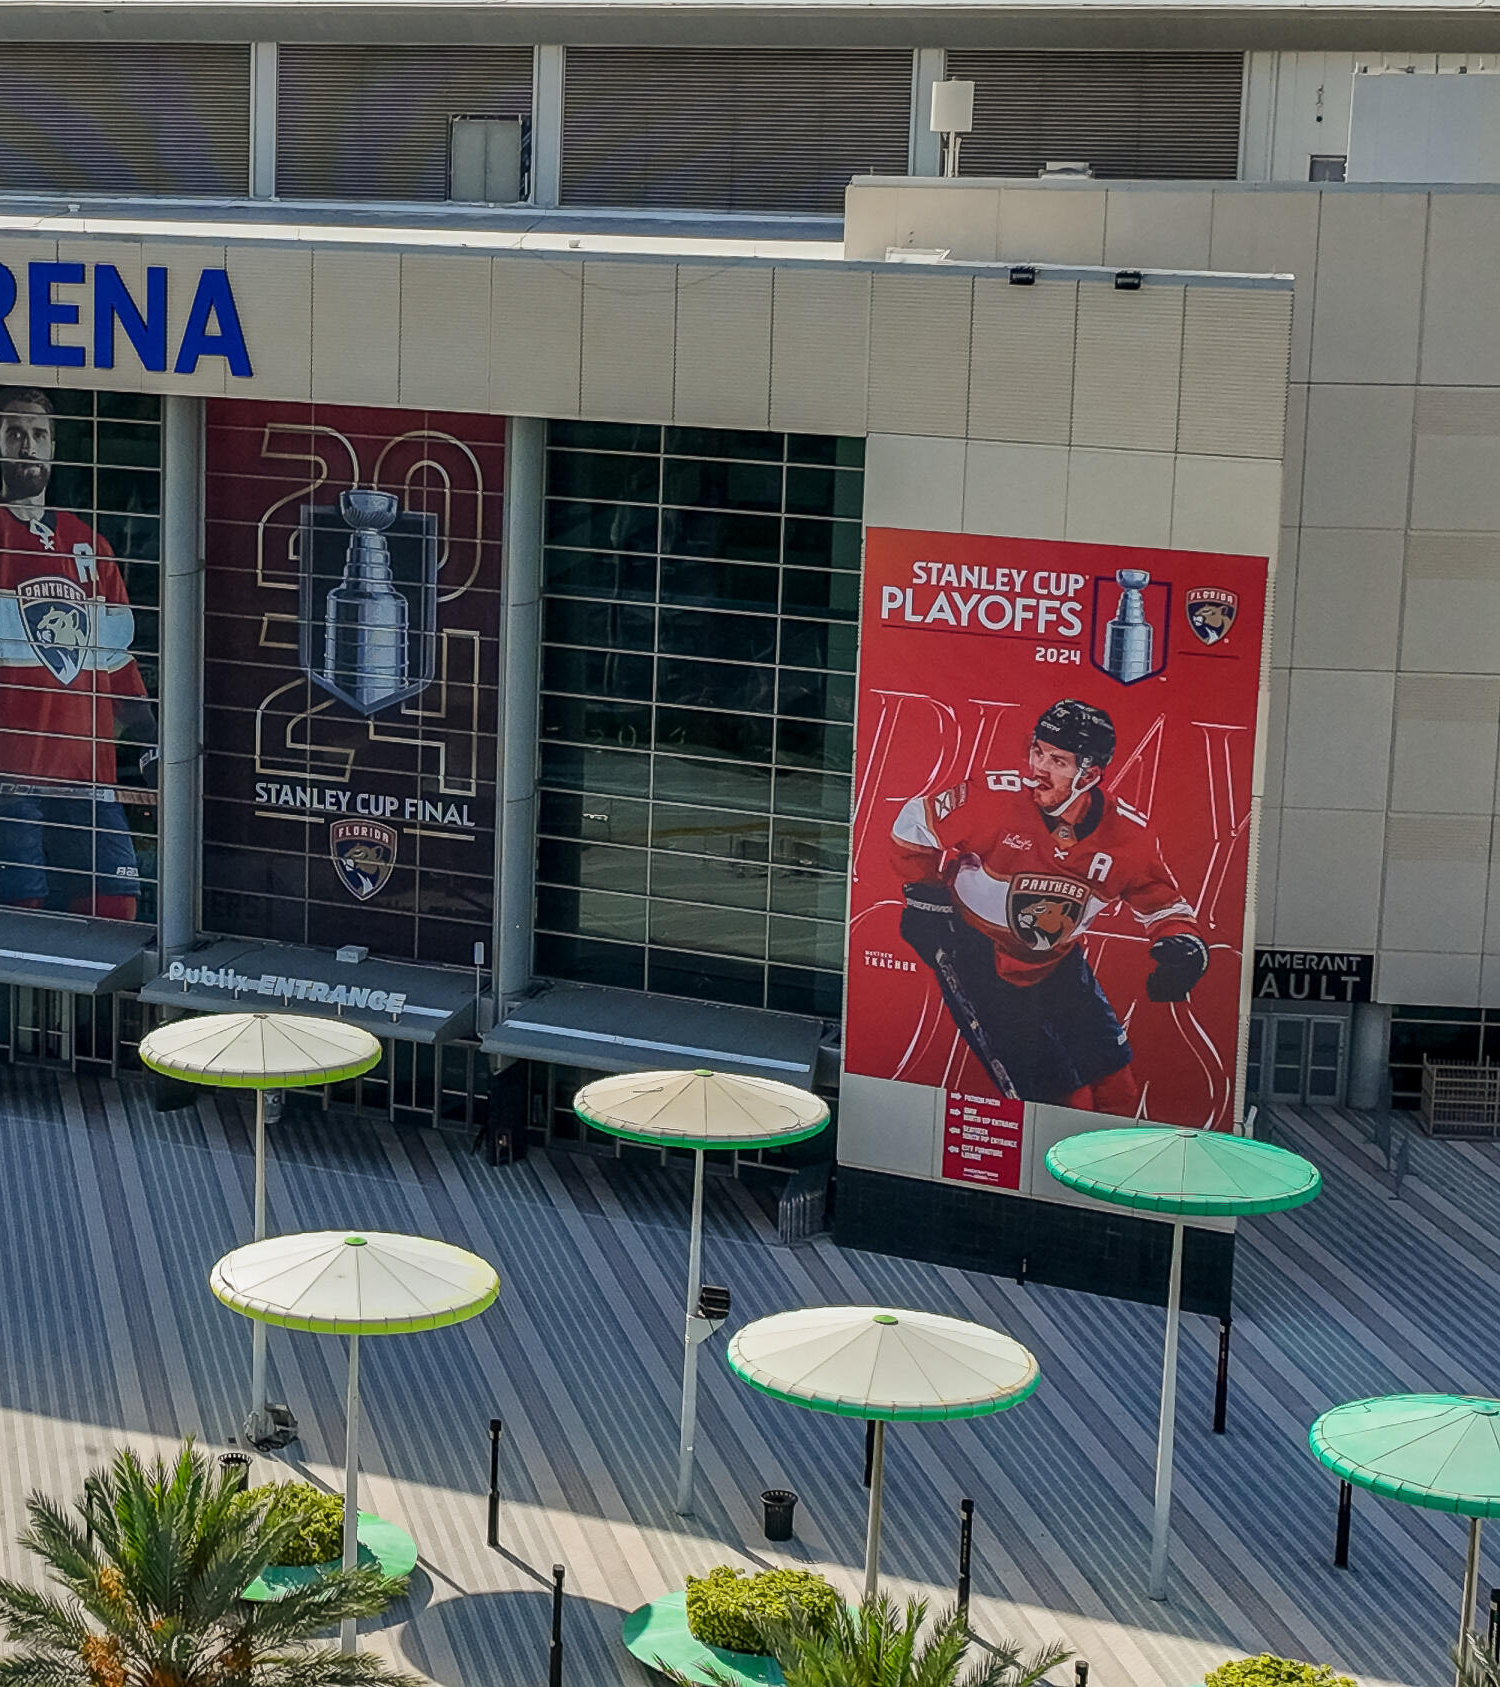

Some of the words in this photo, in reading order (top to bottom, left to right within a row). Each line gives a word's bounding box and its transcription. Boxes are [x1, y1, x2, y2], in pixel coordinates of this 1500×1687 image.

[73, 542, 100, 583] A
[912, 560, 1027, 593] STANLEY
[1032, 571, 1085, 597] CUP
[880, 585, 1083, 638] PLAYOFFS
[1190, 590, 1233, 604] FLORIDA
[1035, 646, 1081, 665] 2024
[255, 782, 351, 812] STANLEY
[356, 793, 399, 817] CUP
[404, 798, 476, 828] FINAL
[338, 823, 390, 844] FLORIDA
[1087, 852, 1113, 882] A
[1019, 878, 1085, 899] PANTHERS
[1259, 953, 1362, 972] AMERANT
[169, 961, 250, 993] Publix
[256, 974, 407, 1015] ENTRANCE
